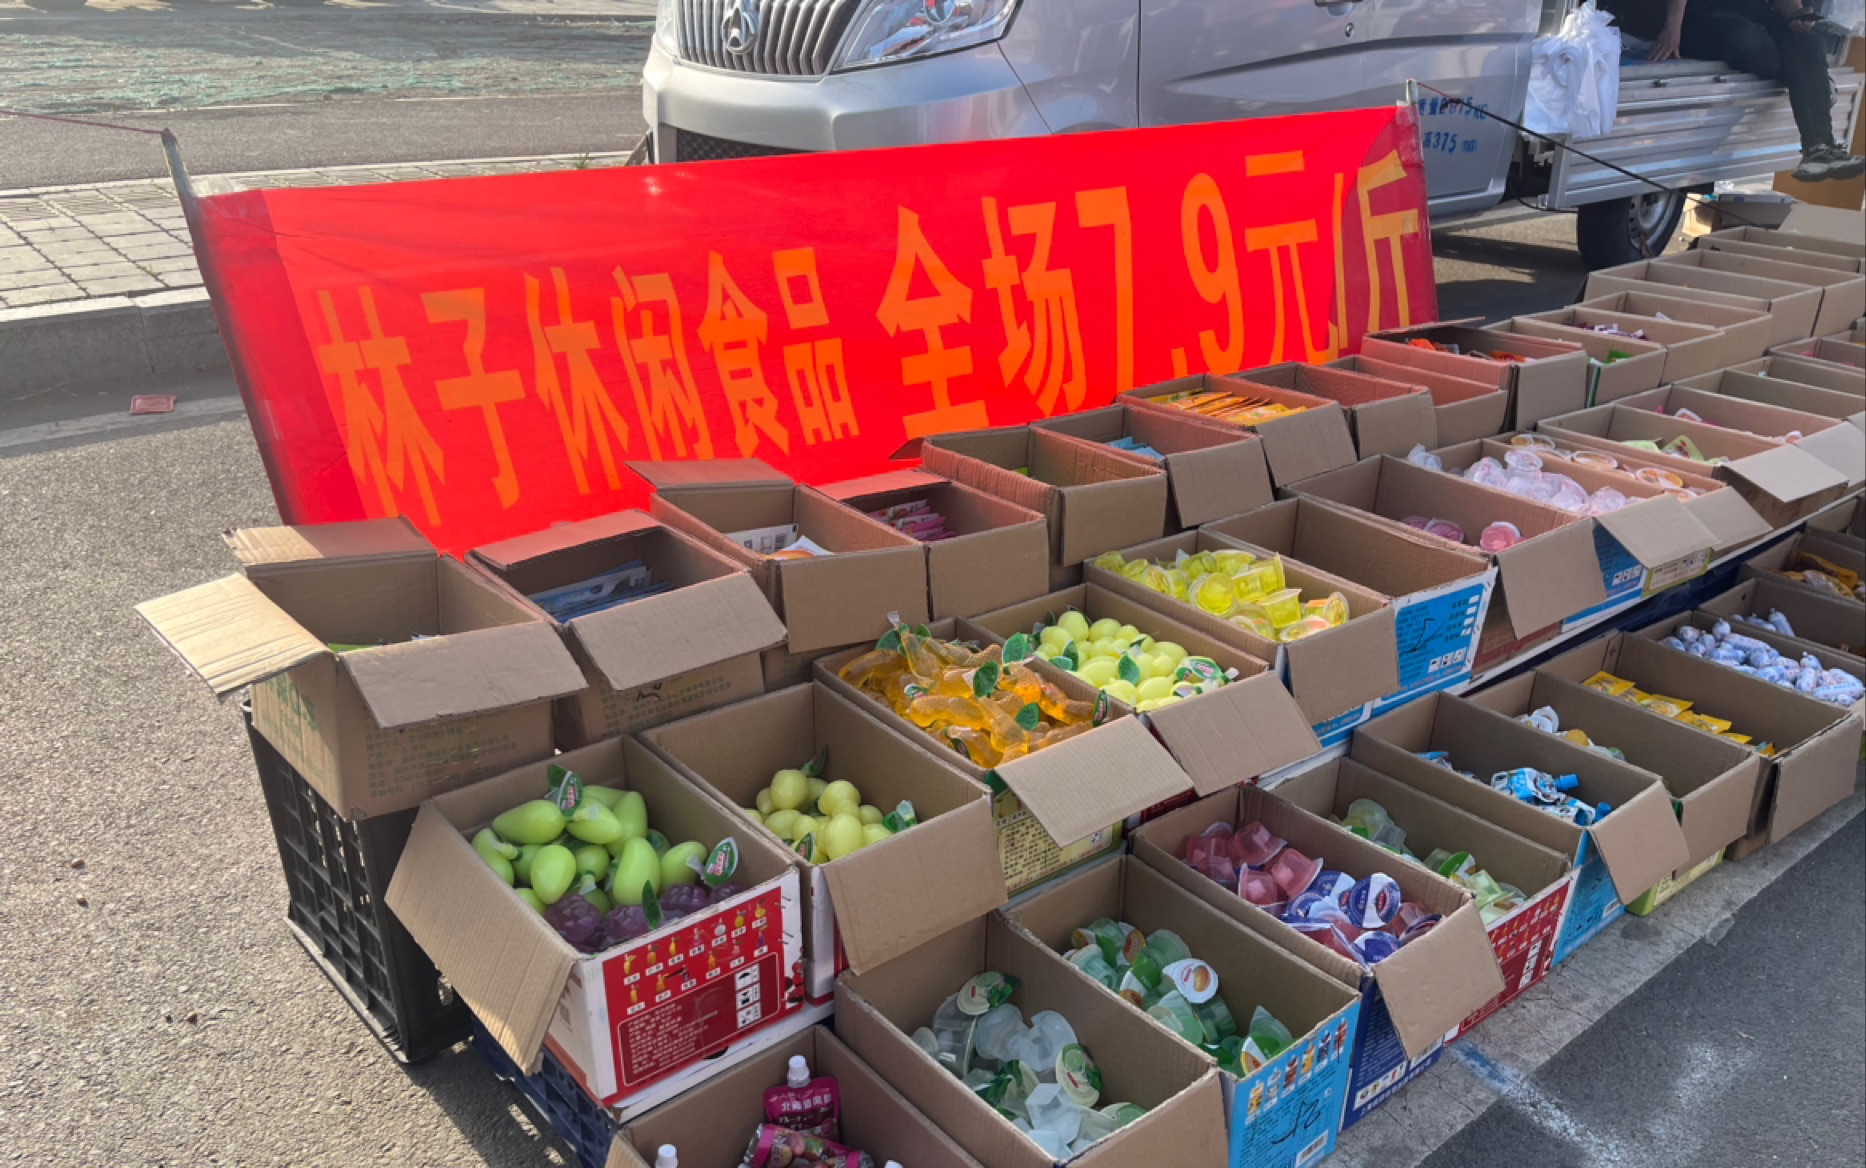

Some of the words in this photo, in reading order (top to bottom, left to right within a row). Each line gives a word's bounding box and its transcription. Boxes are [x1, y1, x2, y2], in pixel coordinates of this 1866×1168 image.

[317, 246, 860, 526] 林子休闲食品
[876, 149, 1420, 440] 全场7.9元/斤
